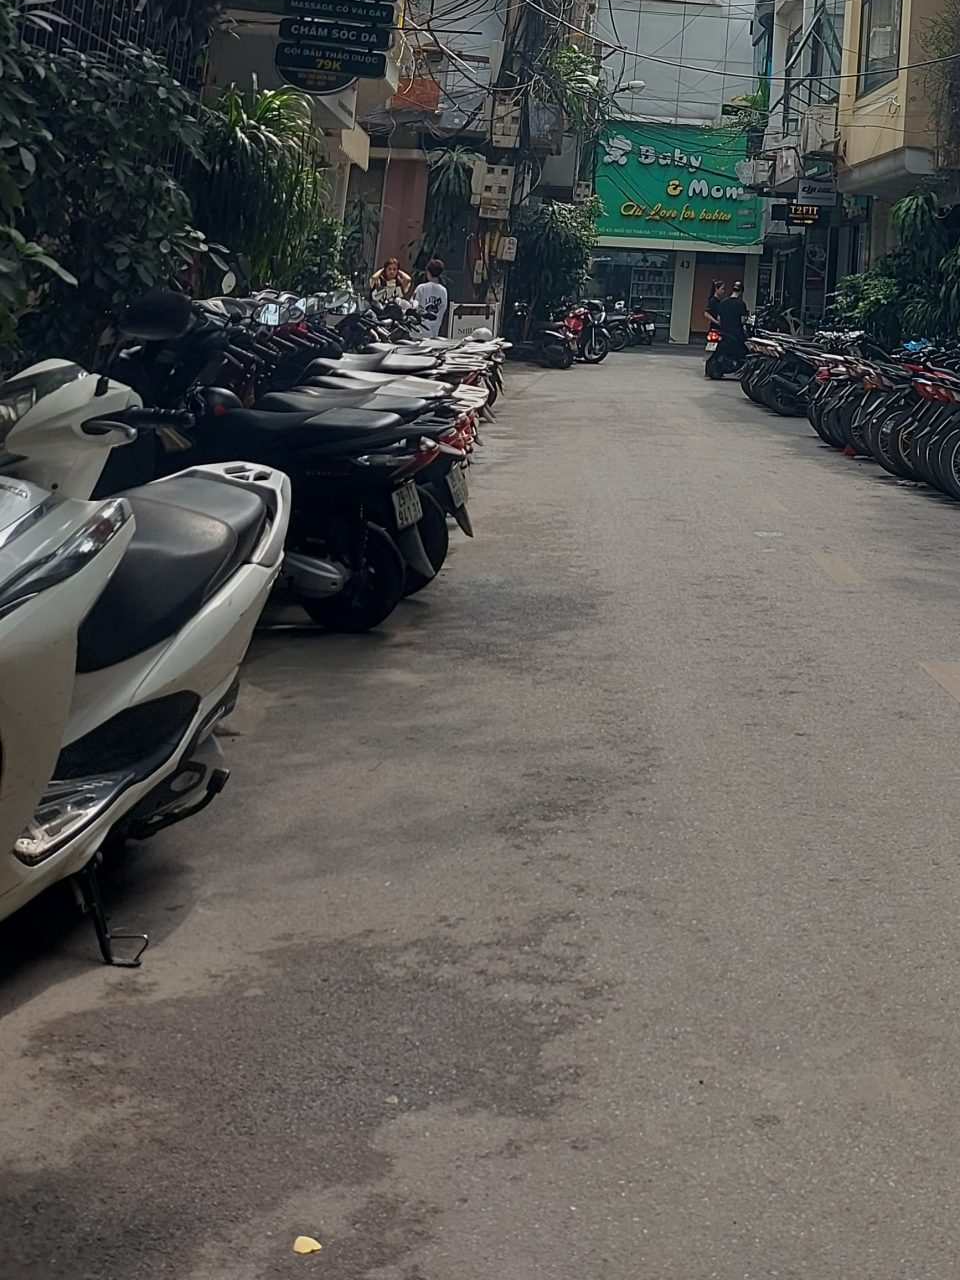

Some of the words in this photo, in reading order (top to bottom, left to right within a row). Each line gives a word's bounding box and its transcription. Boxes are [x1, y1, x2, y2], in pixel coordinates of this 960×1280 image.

[290, 0, 334, 12] MASSAGE
[351, 6, 367, 16] VAI
[360, 32, 378, 43] DA
[315, 58, 343, 71] 79K
[637, 144, 703, 173] Baby
[646, 202, 677, 221] Love
[679, 203, 696, 223] for
[699, 207, 732, 222] babies
[789, 205, 820, 215] T2FIT
[679, 260, 691, 270] 43
